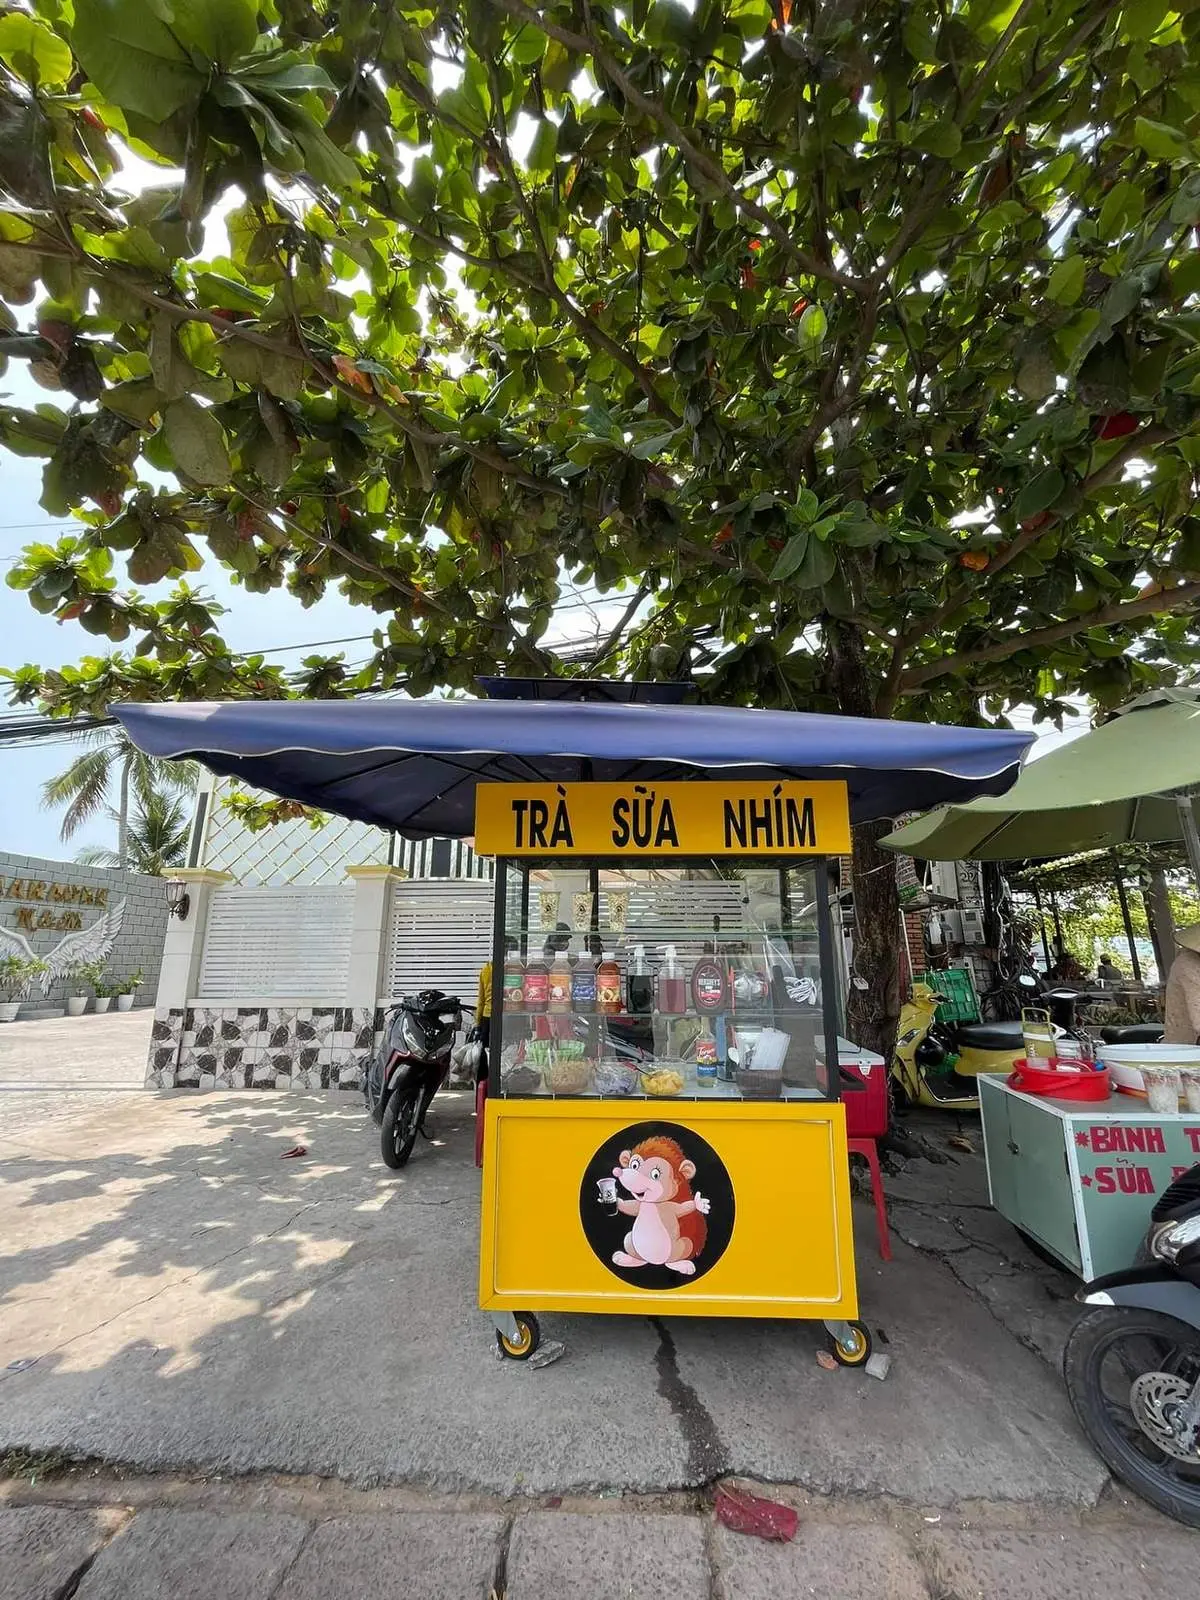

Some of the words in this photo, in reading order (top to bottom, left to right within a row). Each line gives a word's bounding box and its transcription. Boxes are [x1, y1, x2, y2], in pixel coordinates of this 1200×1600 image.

[512, 784, 573, 848] TRÀ
[612, 785, 679, 848] SỮA
[723, 783, 817, 849] NHÍM
[1090, 1120, 1166, 1153] BÁNH
[1094, 1157, 1155, 1194] SỮA
